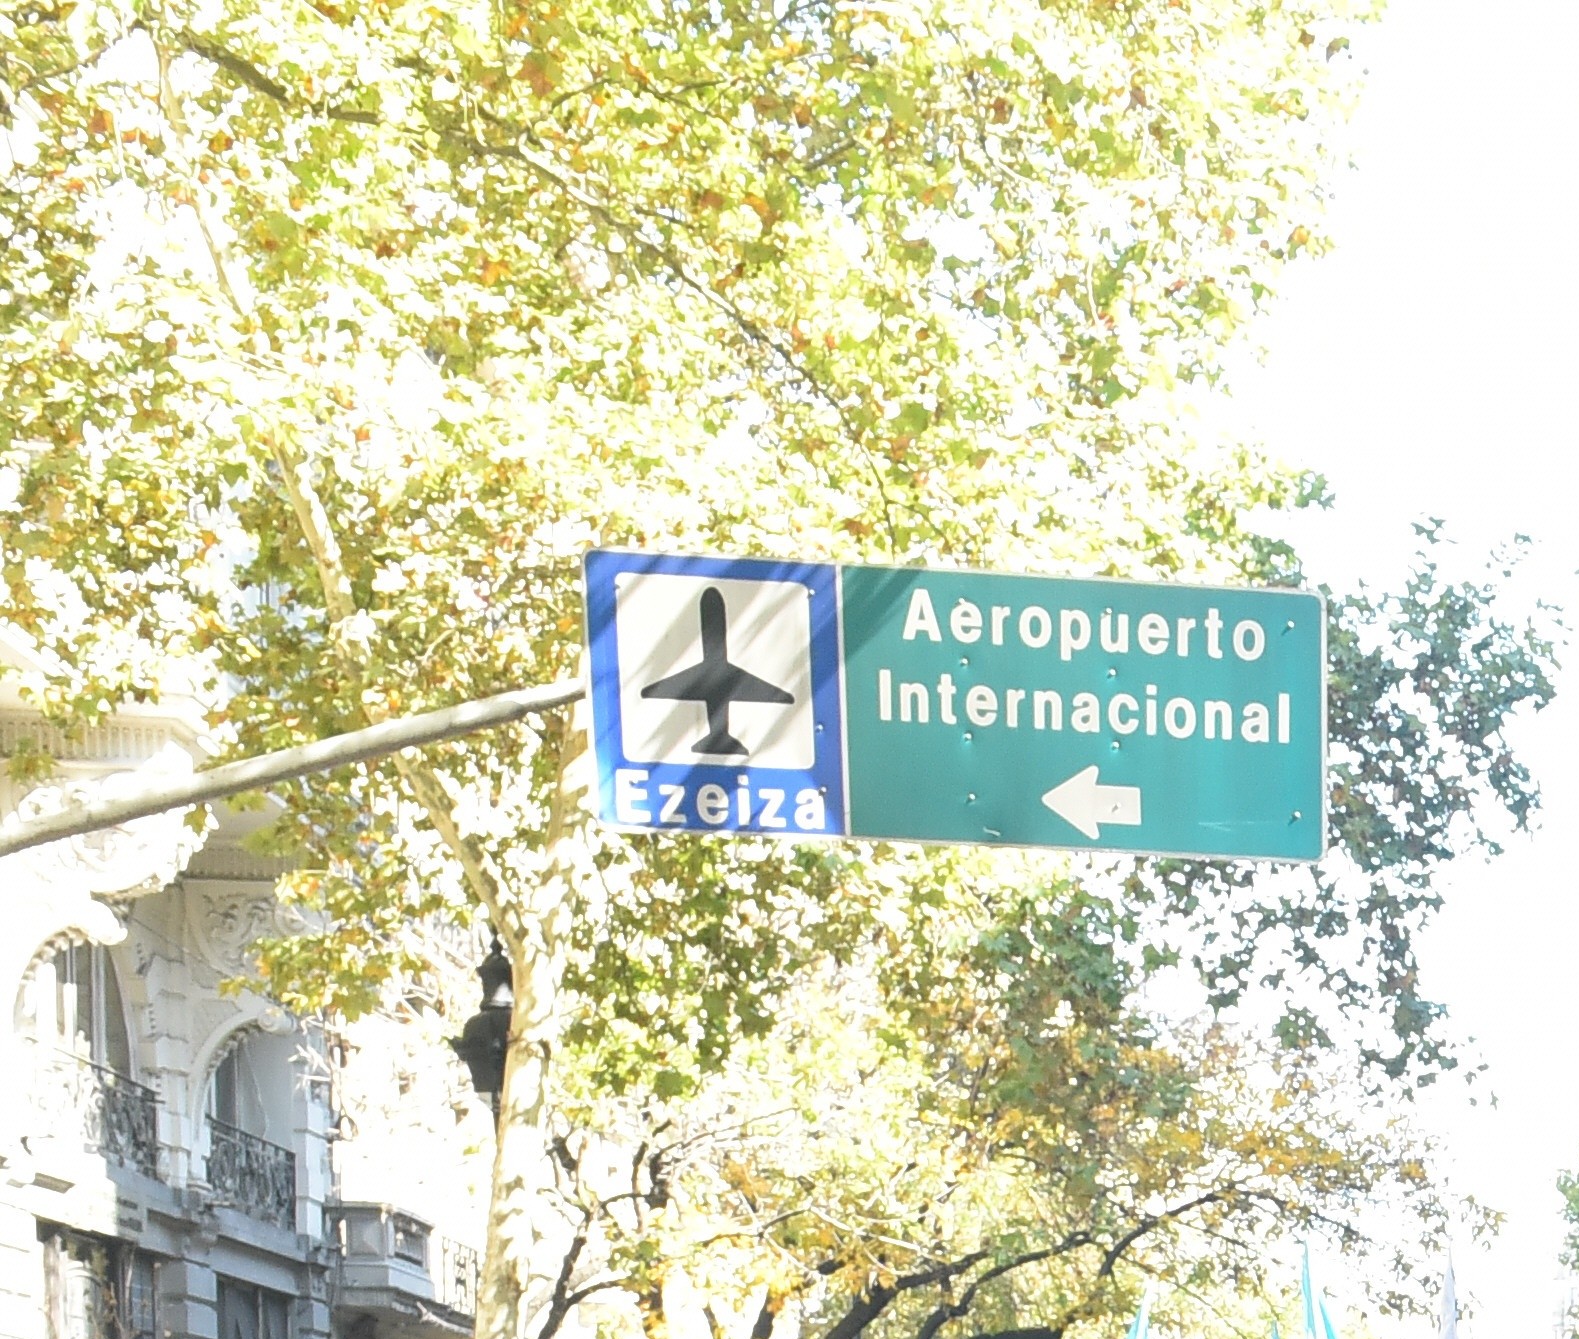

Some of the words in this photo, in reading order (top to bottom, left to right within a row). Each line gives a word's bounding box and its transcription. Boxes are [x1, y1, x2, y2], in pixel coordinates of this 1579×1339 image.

[902, 589, 1266, 661] Aeropuerto
[878, 668, 1291, 744] Internacional
[615, 769, 827, 831] Ezeiza
